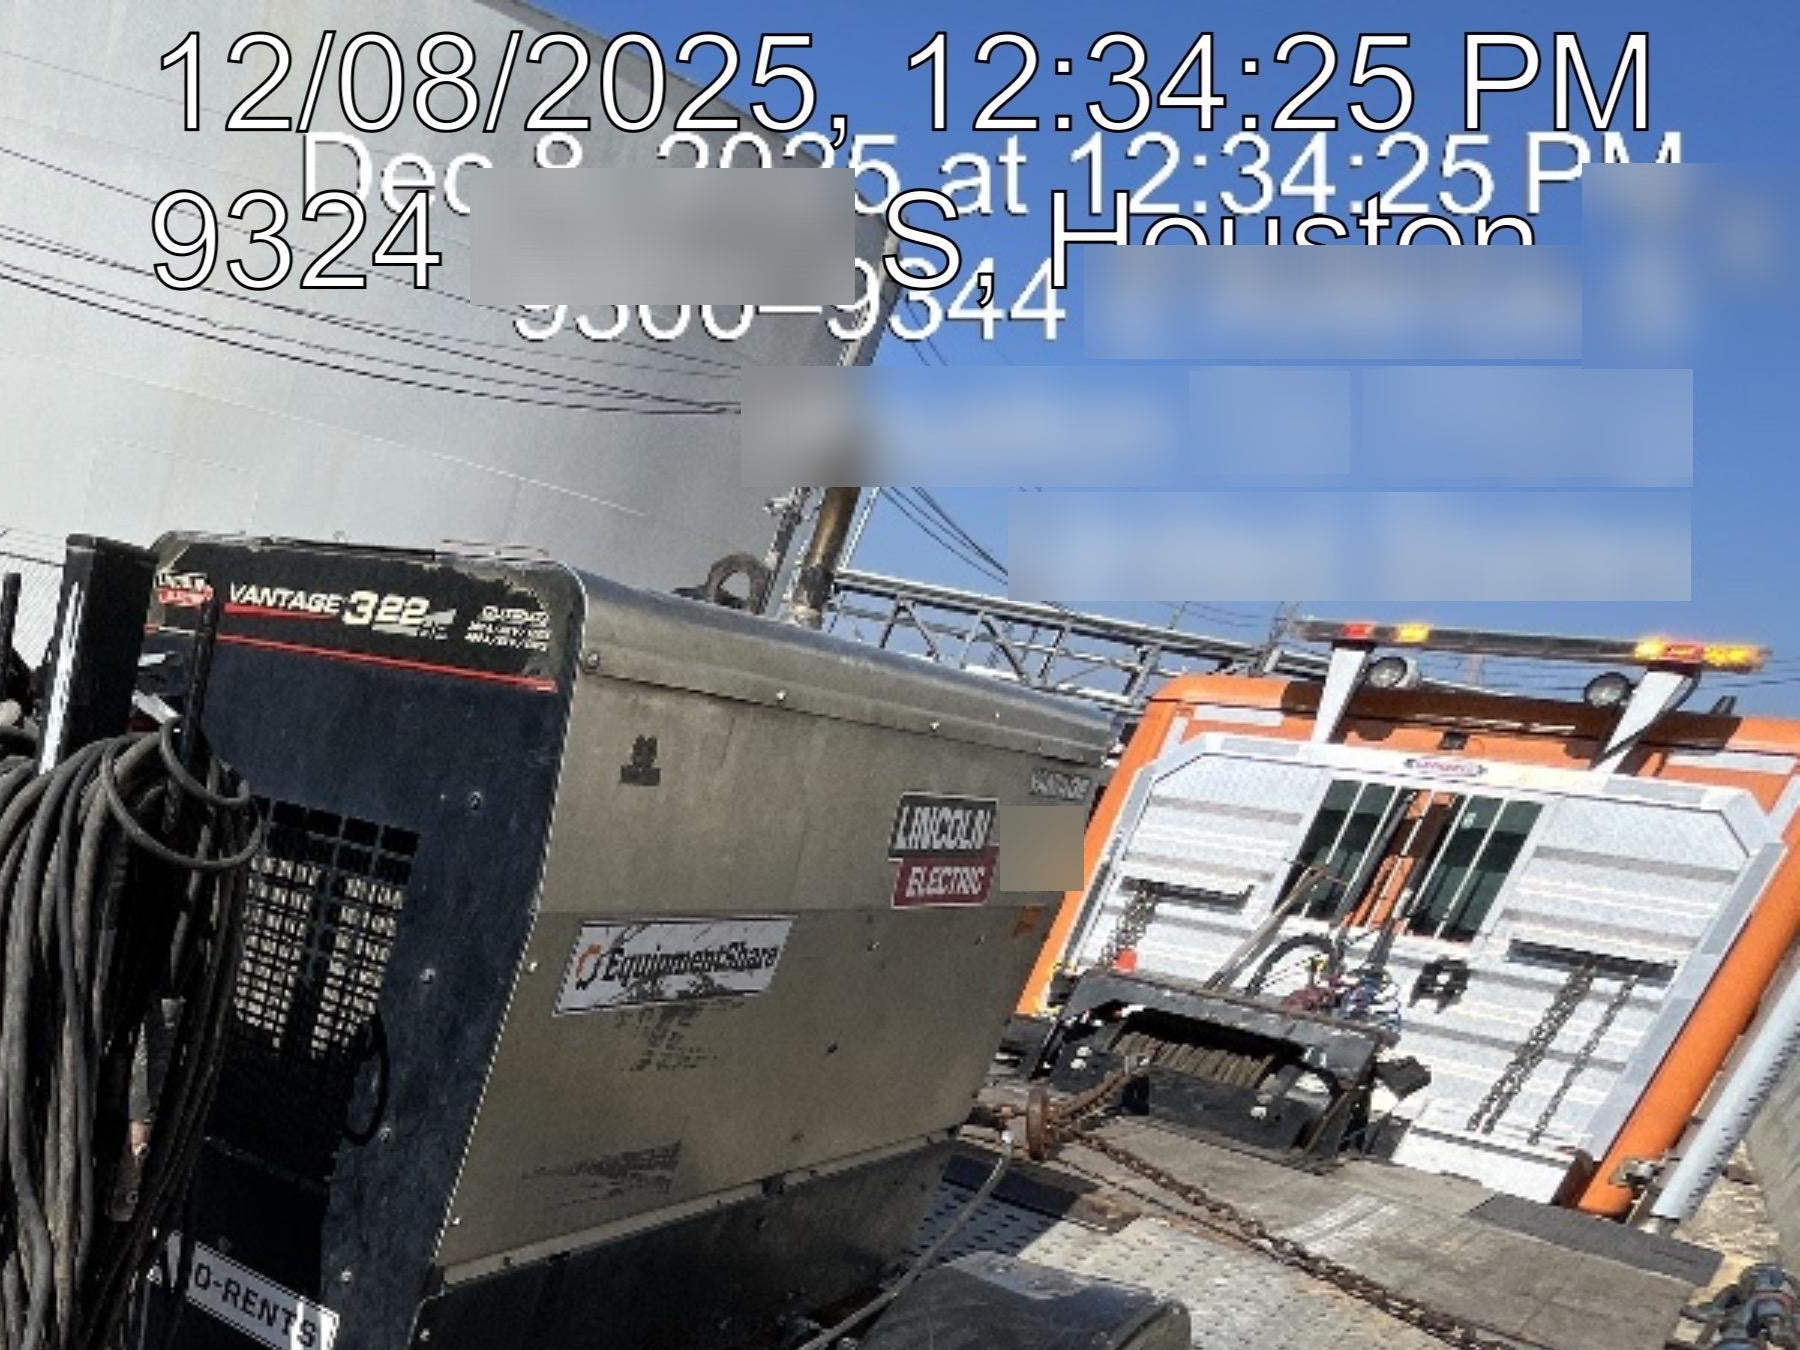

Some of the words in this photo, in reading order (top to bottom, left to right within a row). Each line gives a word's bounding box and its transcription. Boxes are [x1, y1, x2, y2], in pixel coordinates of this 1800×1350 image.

[229, 581, 344, 613] VANTAGE
[342, 590, 430, 625] 322
[895, 806, 991, 850] LINCOLN
[905, 866, 985, 898] ELECTRIC
